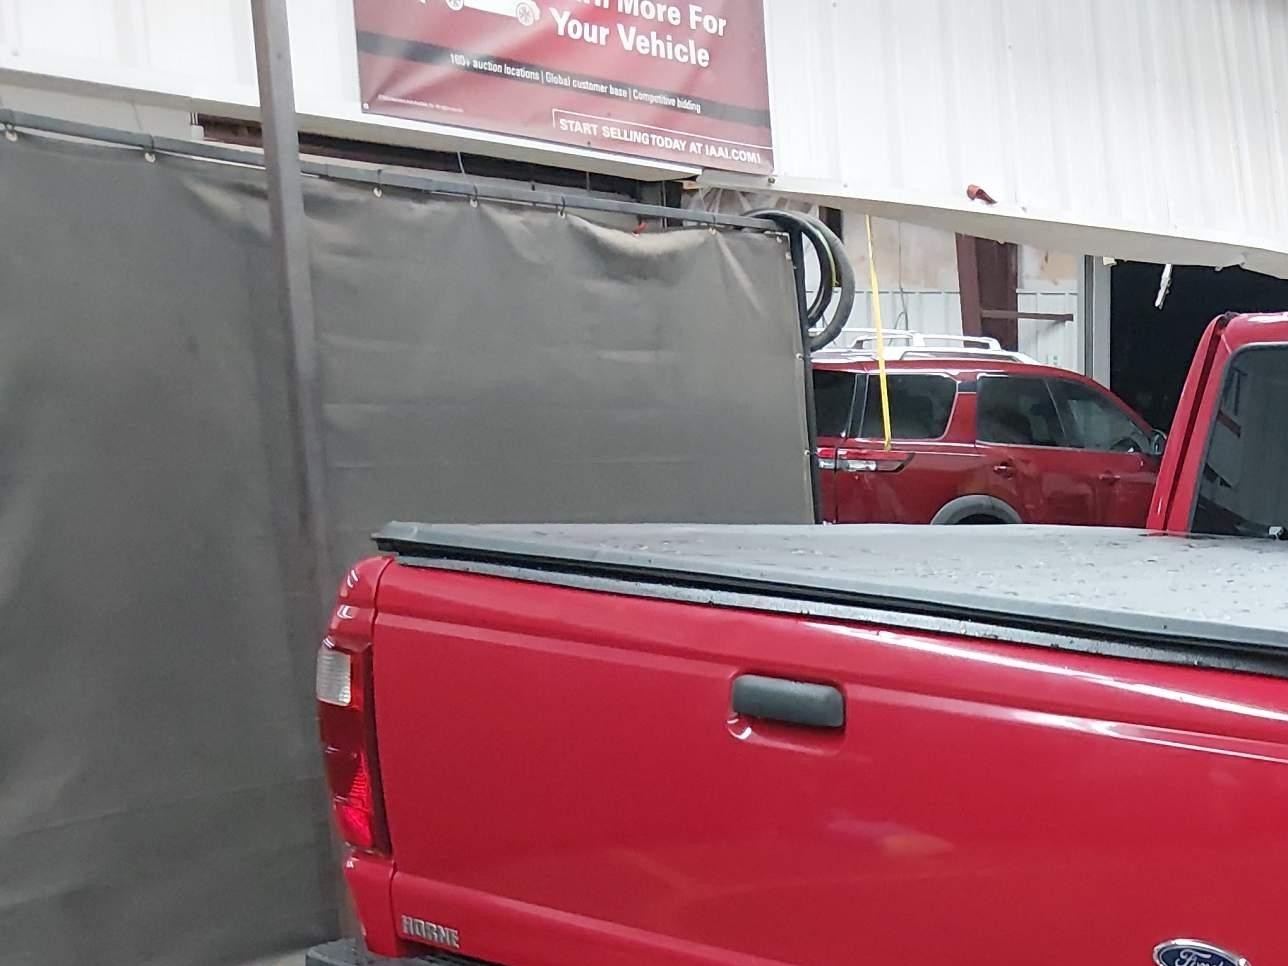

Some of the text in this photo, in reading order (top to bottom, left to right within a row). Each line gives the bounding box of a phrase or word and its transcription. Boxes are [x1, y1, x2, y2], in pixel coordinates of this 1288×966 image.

[549, 7, 710, 67] Your Vehicle
[617, 0, 727, 37] More For
[472, 60, 503, 74] auction
[503, 63, 541, 81] locations
[545, 71, 571, 87] Global
[572, 79, 609, 93] customer
[609, 84, 628, 98] base
[633, 89, 676, 106] Competitive
[676, 97, 701, 114] bidding
[559, 118, 761, 164] START SELLING TODAY AT IAAI.COM!
[401, 914, 460, 949] HORNE
